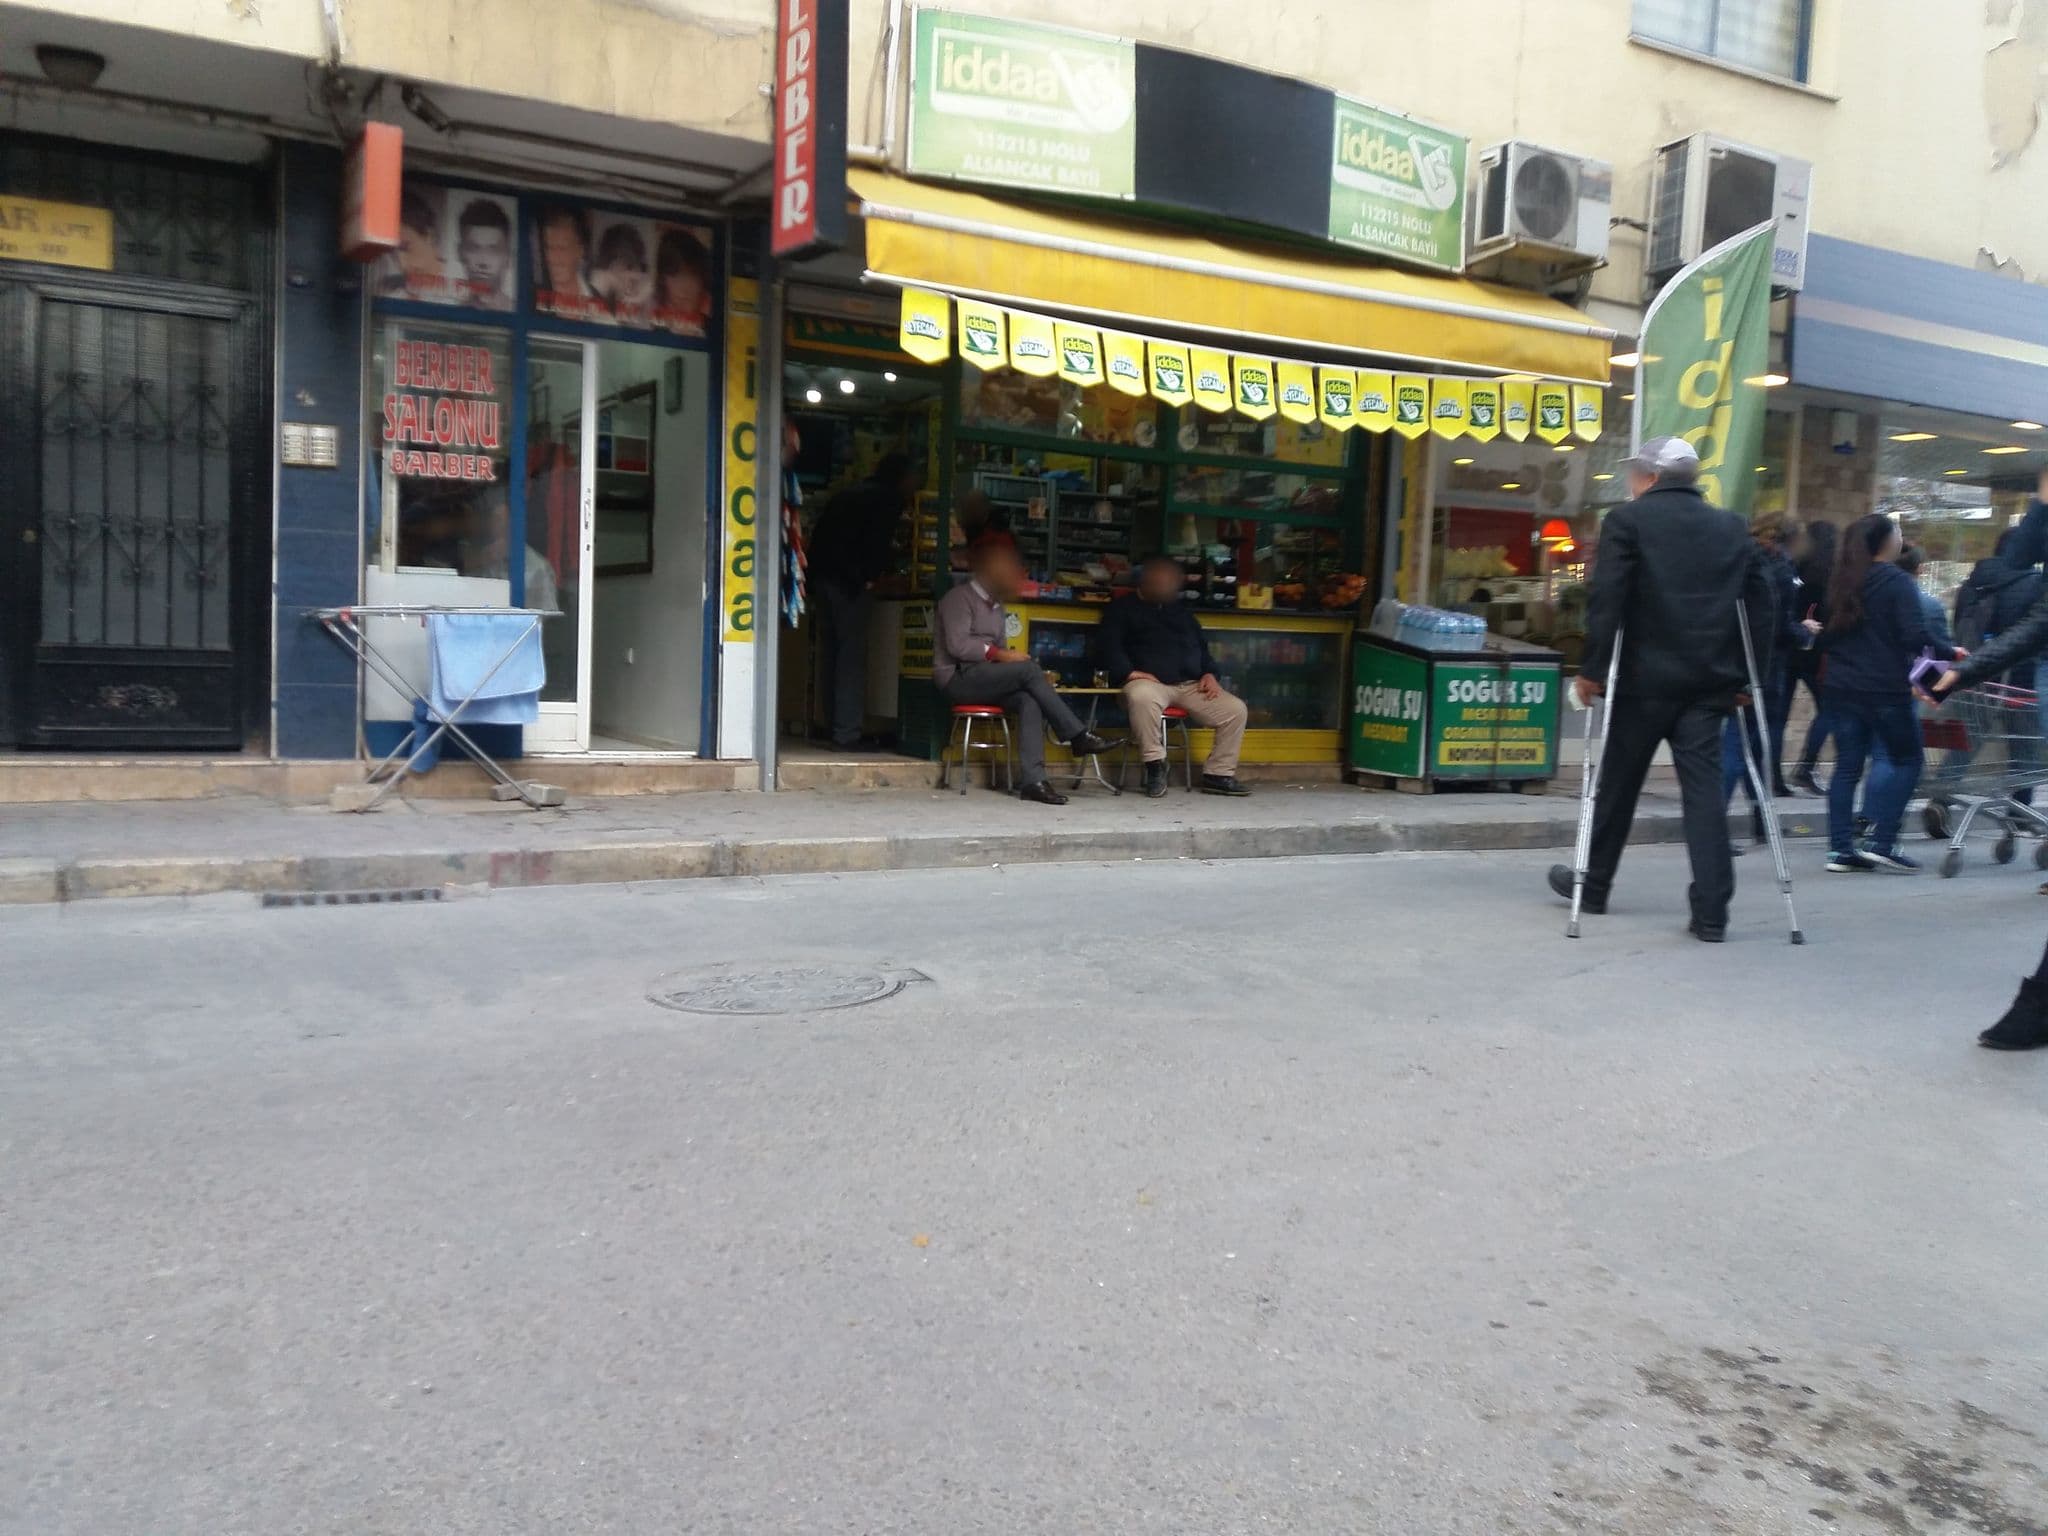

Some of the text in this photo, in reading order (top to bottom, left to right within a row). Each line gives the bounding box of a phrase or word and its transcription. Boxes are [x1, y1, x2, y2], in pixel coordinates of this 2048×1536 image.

[943, 41, 1059, 100] iddaa
[1341, 122, 1415, 181] iddaa
[1351, 221, 1409, 249] ALSANCAK
[1401, 213, 1432, 234] NOLU
[967, 315, 997, 333] iddaa
[1064, 337, 1093, 354] iddaa
[394, 340, 496, 394] BERBER
[1156, 356, 1183, 371] iddaa
[1241, 370, 1268, 385] iddaa
[383, 392, 499, 448] SALONU
[391, 449, 496, 481] BARBER
[1355, 679, 1423, 721] SOĞUK SU
[1447, 674, 1547, 704] SOĞUK SU
